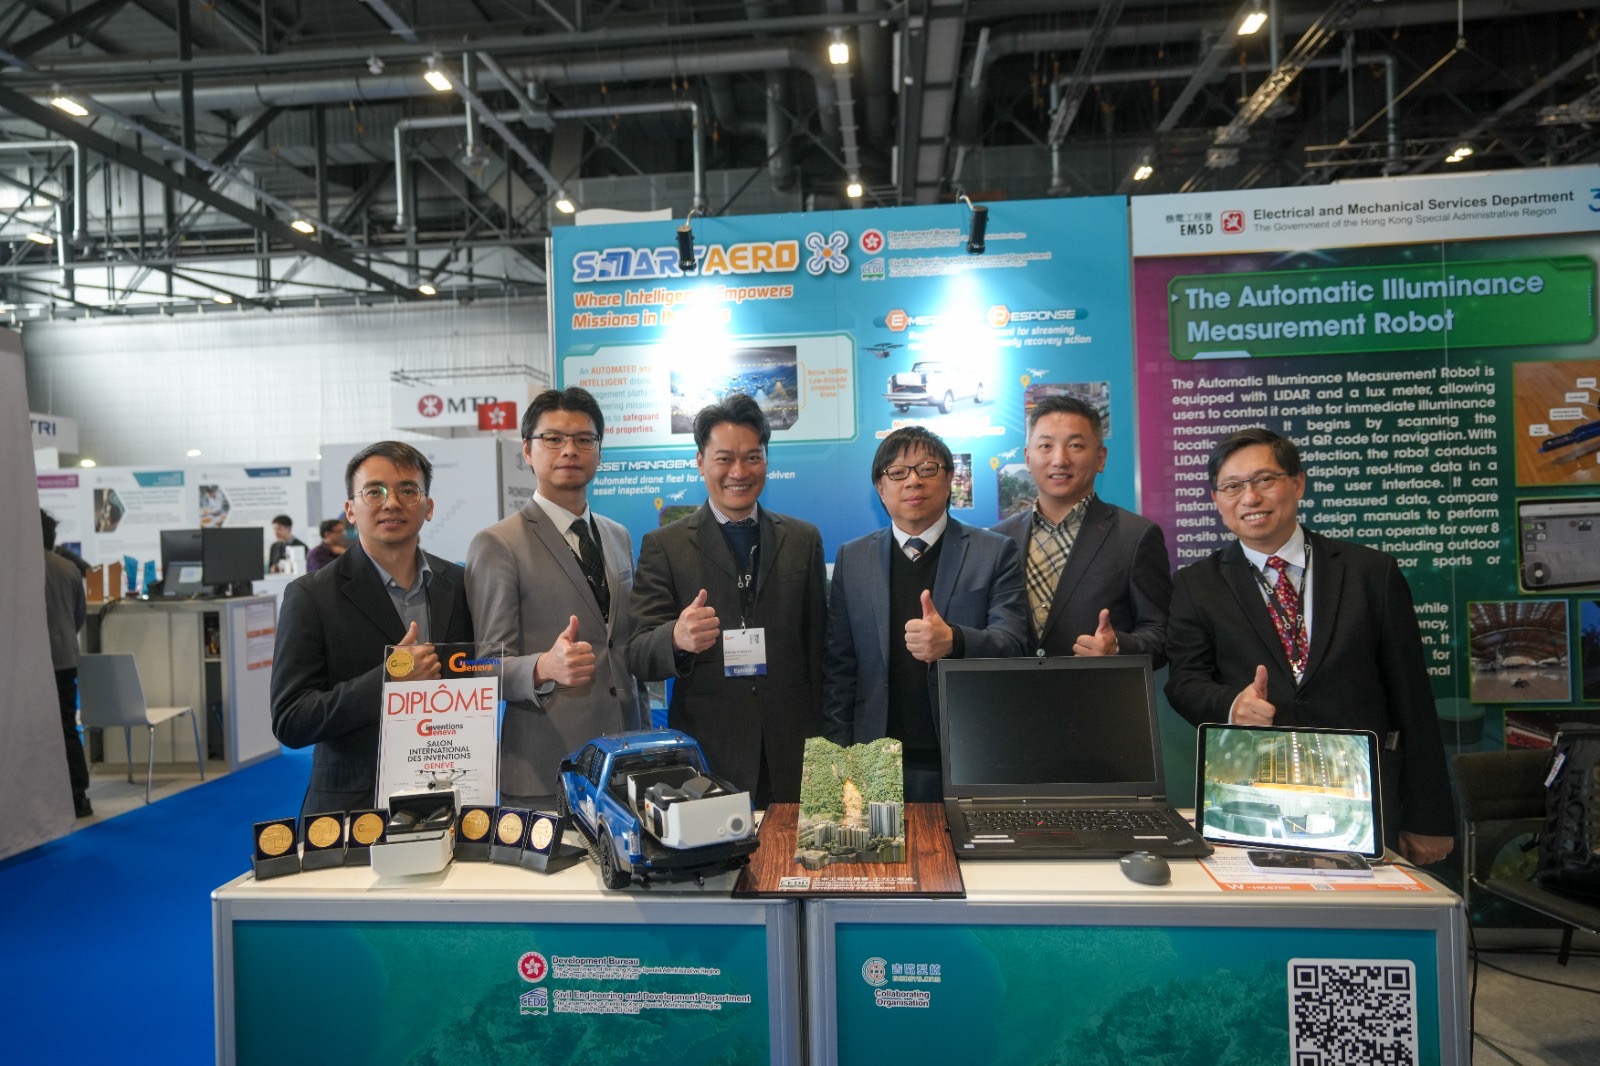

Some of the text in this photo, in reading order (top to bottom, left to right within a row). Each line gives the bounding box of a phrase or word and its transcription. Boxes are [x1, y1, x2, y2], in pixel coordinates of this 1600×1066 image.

[1254, 191, 1574, 220] Electrical and Mechanical Services Department
[1254, 206, 1557, 232] The Government of the Hong Kong Special Administrative Region
[1180, 223, 1213, 236] EMSD
[1185, 275, 1544, 309] The Automatic Illuminance
[575, 293, 621, 307] Where
[573, 311, 656, 328] Missions in
[992, 309, 1076, 322] RESPONSE
[1017, 327, 1029, 336] for
[1031, 326, 1074, 336] streaming
[1187, 309, 1454, 343] Measurement Robot
[1024, 336, 1091, 346] recovery action
[591, 366, 636, 374] AUTOMATED
[580, 378, 627, 387] INTELLIGENT
[1172, 366, 1495, 389] The Automatic Illuminance Measurement Robot is
[1172, 382, 1495, 406] equipped with LIDAR and a lux meter, allowing
[1173, 399, 1495, 420] users to control it on-site for immediate illuminance
[623, 414, 659, 422] safeguard
[1174, 413, 1496, 435] measurements. It begins by scanning the
[616, 425, 656, 436] properties.
[1312, 435, 1332, 446] QR
[1335, 435, 1369, 445] code
[1372, 433, 1389, 443] for
[1392, 430, 1466, 444] navigation.
[1468, 429, 1496, 439] With
[1300, 445, 1497, 462] detection, the robot conducts
[1307, 461, 1497, 478] displays real-time data in a
[594, 476, 638, 486] Automated
[640, 476, 664, 484] drone
[666, 474, 685, 483] fleet
[687, 473, 698, 482] for
[593, 486, 659, 496] asset inspection
[1175, 477, 1498, 498] map the user interface. It can
[1323, 495, 1388, 507] measured
[1396, 494, 1431, 506] data,
[1438, 492, 1498, 505] compare
[1176, 517, 1216, 527] results
[1313, 512, 1356, 525] design
[1364, 510, 1420, 521] manuals
[1427, 509, 1440, 519] to
[1447, 508, 1499, 521] perform
[1177, 531, 1217, 542] on-site
[1320, 527, 1354, 537] robot
[1357, 526, 1382, 537] can
[1385, 525, 1437, 539] operate
[1440, 523, 1457, 535] for
[1460, 524, 1488, 534] over
[1491, 522, 1499, 533] 8
[1177, 548, 1212, 557] hours
[1382, 541, 1443, 553] including
[1447, 539, 1500, 550] outdoor
[1432, 555, 1501, 568] sports or
[1414, 603, 1448, 613] while
[1441, 634, 1450, 644] It
[1432, 649, 1450, 659] for
[388, 683, 493, 715] DIPLÔME
[417, 719, 456, 736] Geneva
[426, 723, 463, 731] inventions
[409, 747, 470, 755] INTERNATIONAL
[424, 753, 471, 761] INVENTIONS
[552, 957, 639, 965] Development Bureau
[553, 991, 751, 1003] Civil Engineering and Development Department
[875, 989, 930, 1000] Collaborating
[521, 997, 547, 1006] CEDD
[877, 999, 929, 1008] Organisation
